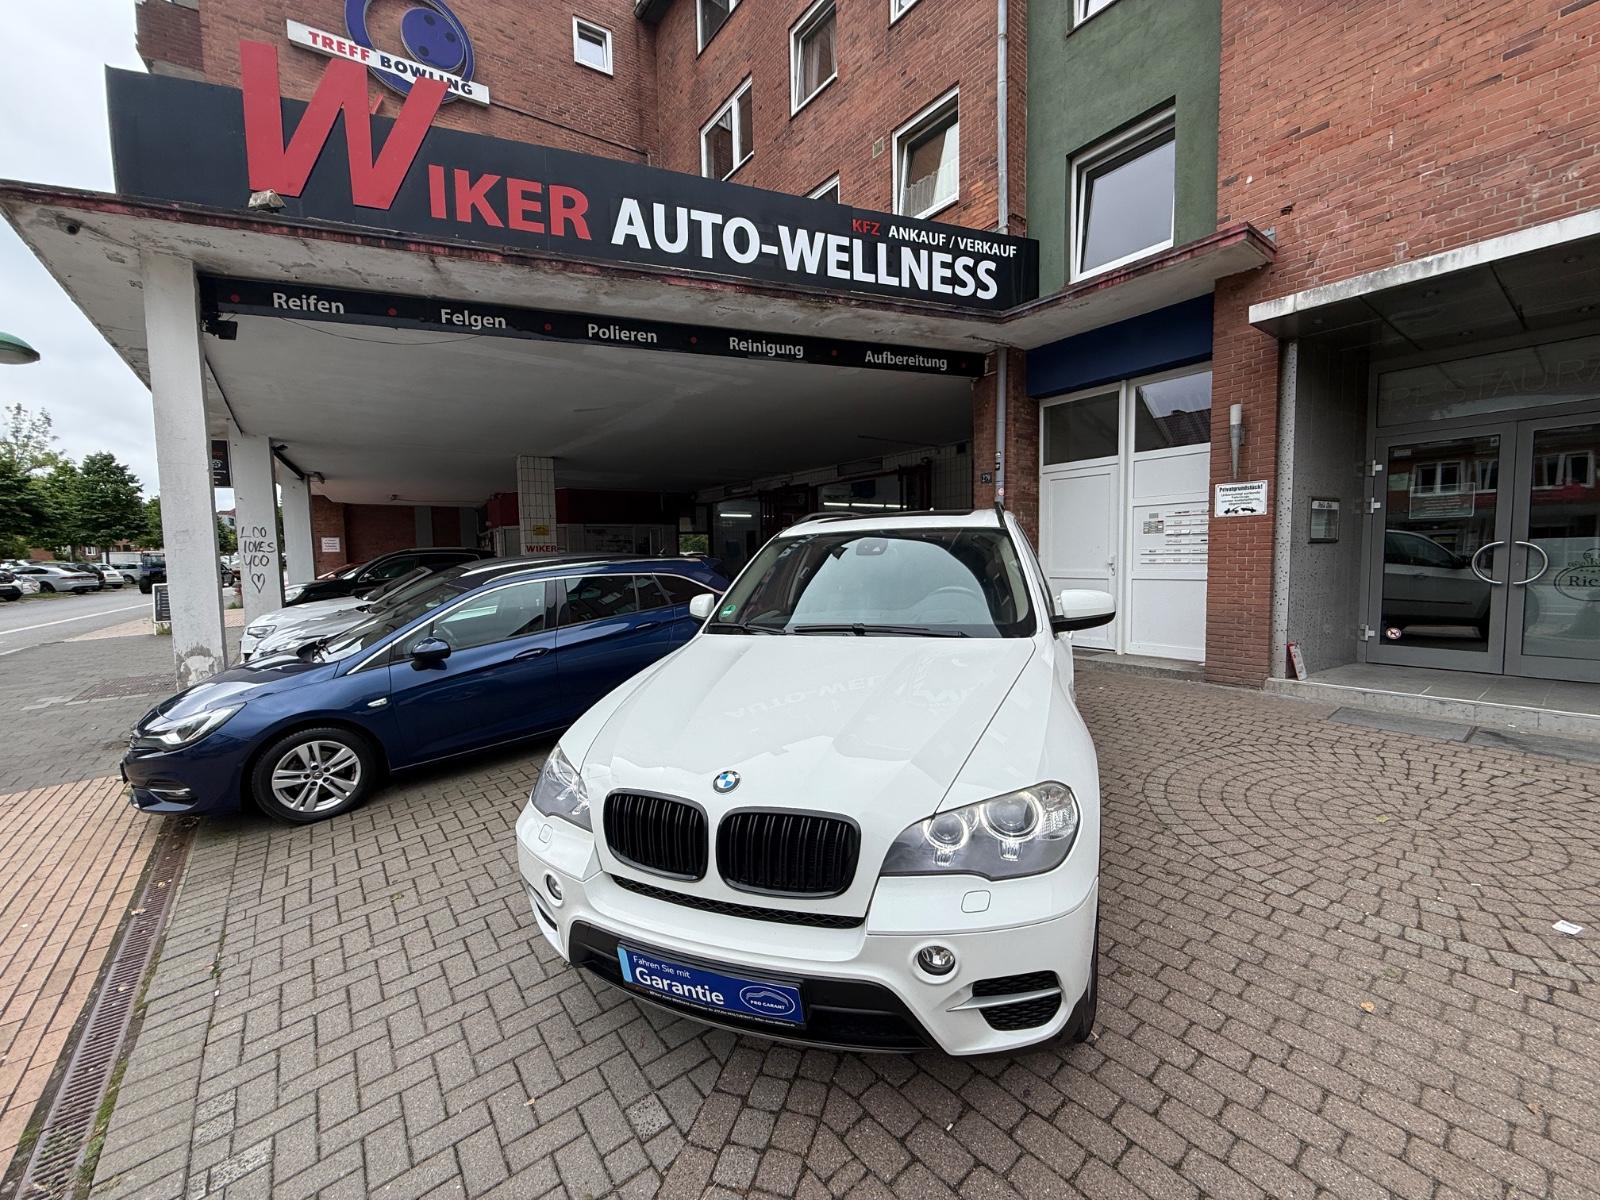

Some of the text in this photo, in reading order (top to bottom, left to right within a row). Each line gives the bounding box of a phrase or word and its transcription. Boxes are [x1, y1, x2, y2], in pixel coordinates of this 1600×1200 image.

[308, 30, 370, 62] TREFF
[611, 197, 999, 300] AUTO-WELLNESS
[851, 218, 881, 237] KFZ
[887, 225, 947, 247] ANKAUF
[957, 237, 1017, 259] VERKAUF
[272, 292, 345, 315] Reifen
[440, 308, 507, 331] Felgen
[587, 323, 658, 345] Polieren
[728, 337, 805, 359] Reinigung
[864, 350, 949, 371] Aufbereitung
[526, 545, 557, 553] WIKER
[633, 955, 691, 978] Fahren Sie mit
[635, 966, 725, 1005] Garantie
[762, 1001, 786, 1010] GARANT
